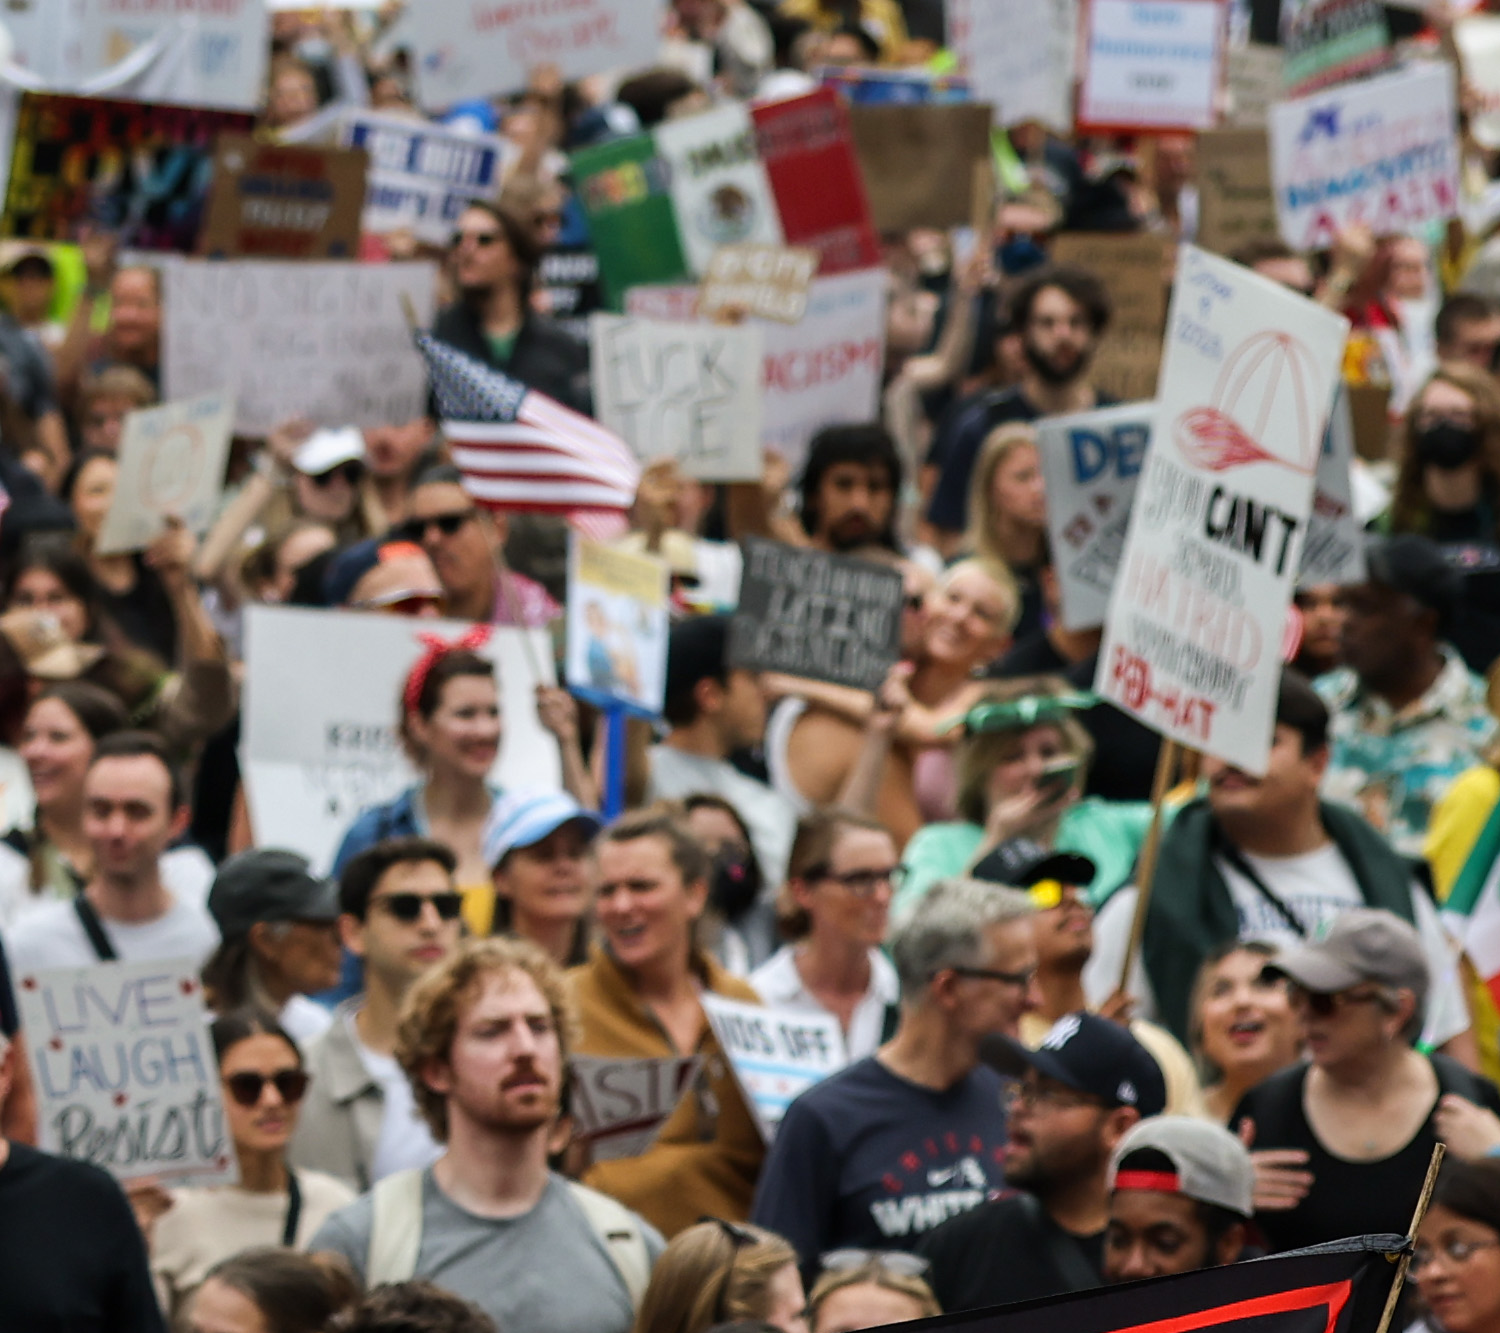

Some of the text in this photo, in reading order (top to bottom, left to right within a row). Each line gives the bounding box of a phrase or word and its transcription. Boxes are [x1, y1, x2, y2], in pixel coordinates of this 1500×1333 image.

[1204, 484, 1301, 576] CAN'T
[42, 974, 180, 1034] LIVE
[34, 1034, 204, 1099] LAUGH
[781, 1029, 838, 1066] OFF
